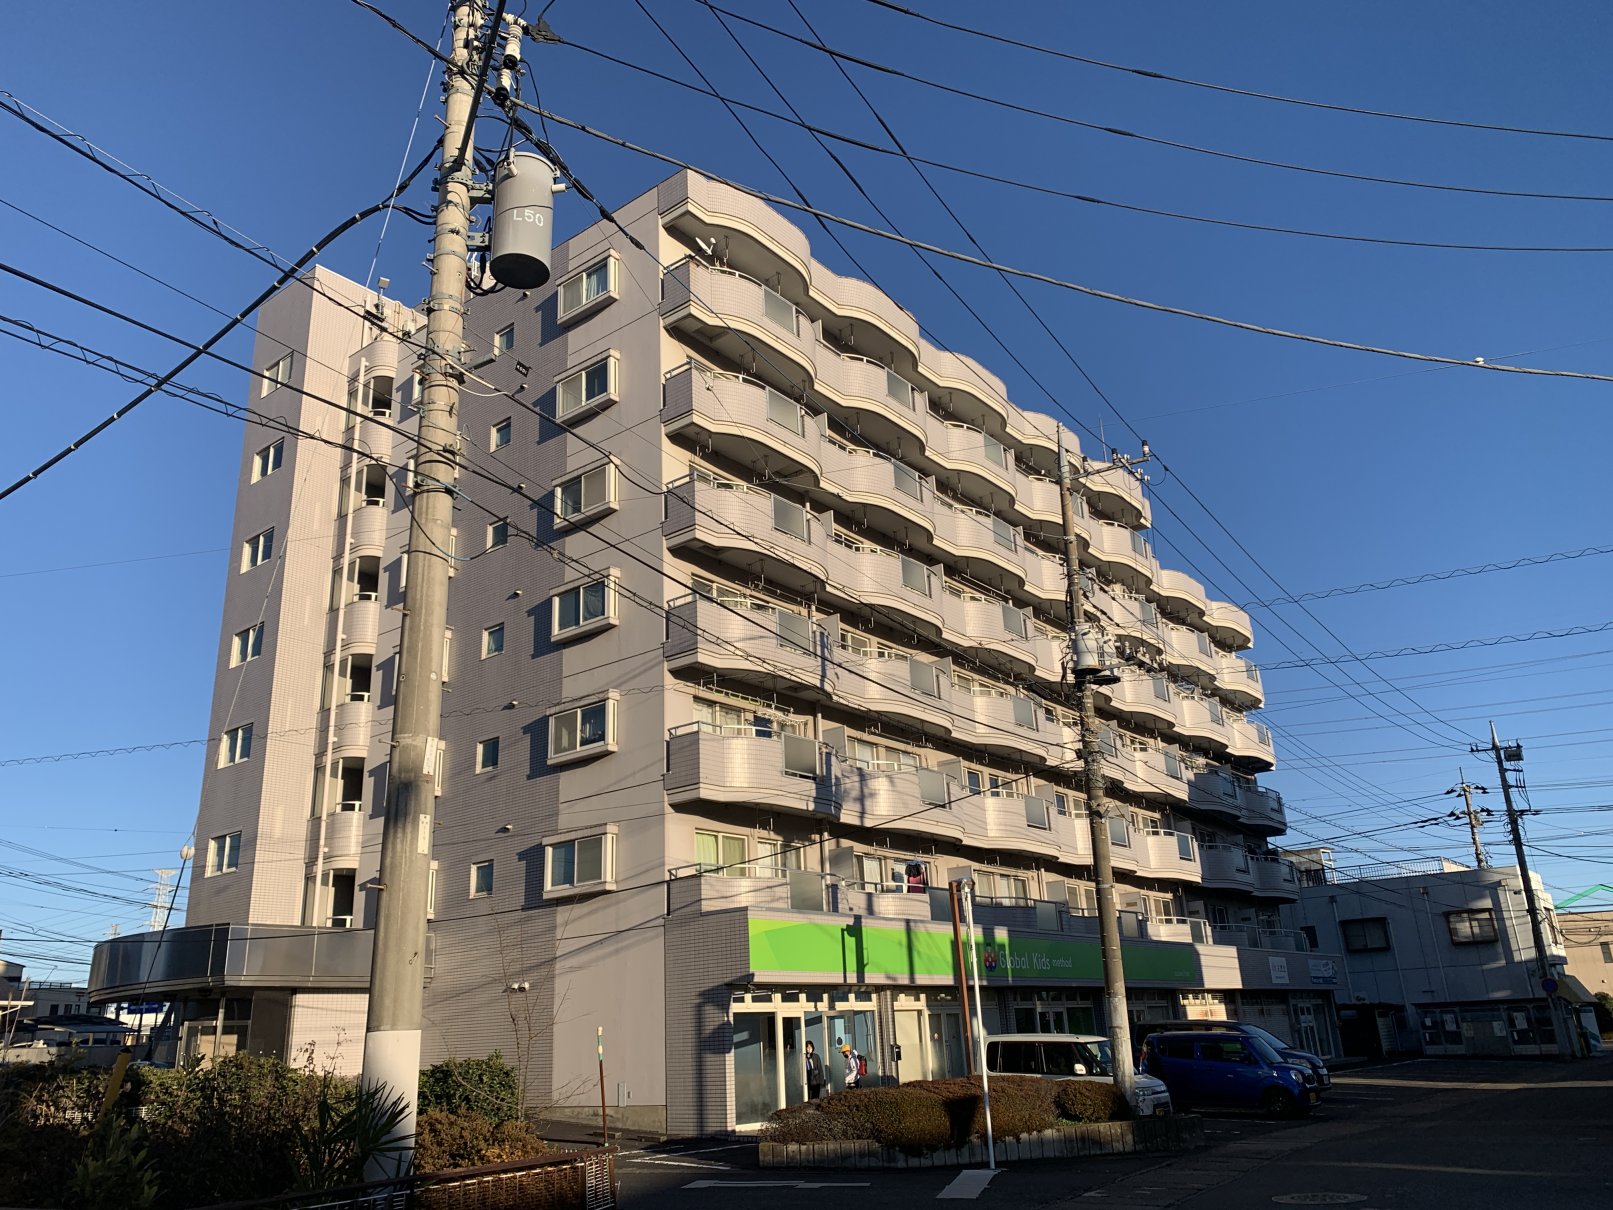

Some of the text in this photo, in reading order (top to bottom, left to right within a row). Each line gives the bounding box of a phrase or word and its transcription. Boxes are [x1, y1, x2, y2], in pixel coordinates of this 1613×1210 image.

[513, 209, 544, 227] L50
[999, 951, 1030, 969] Global
[1032, 953, 1051, 970] Kids
